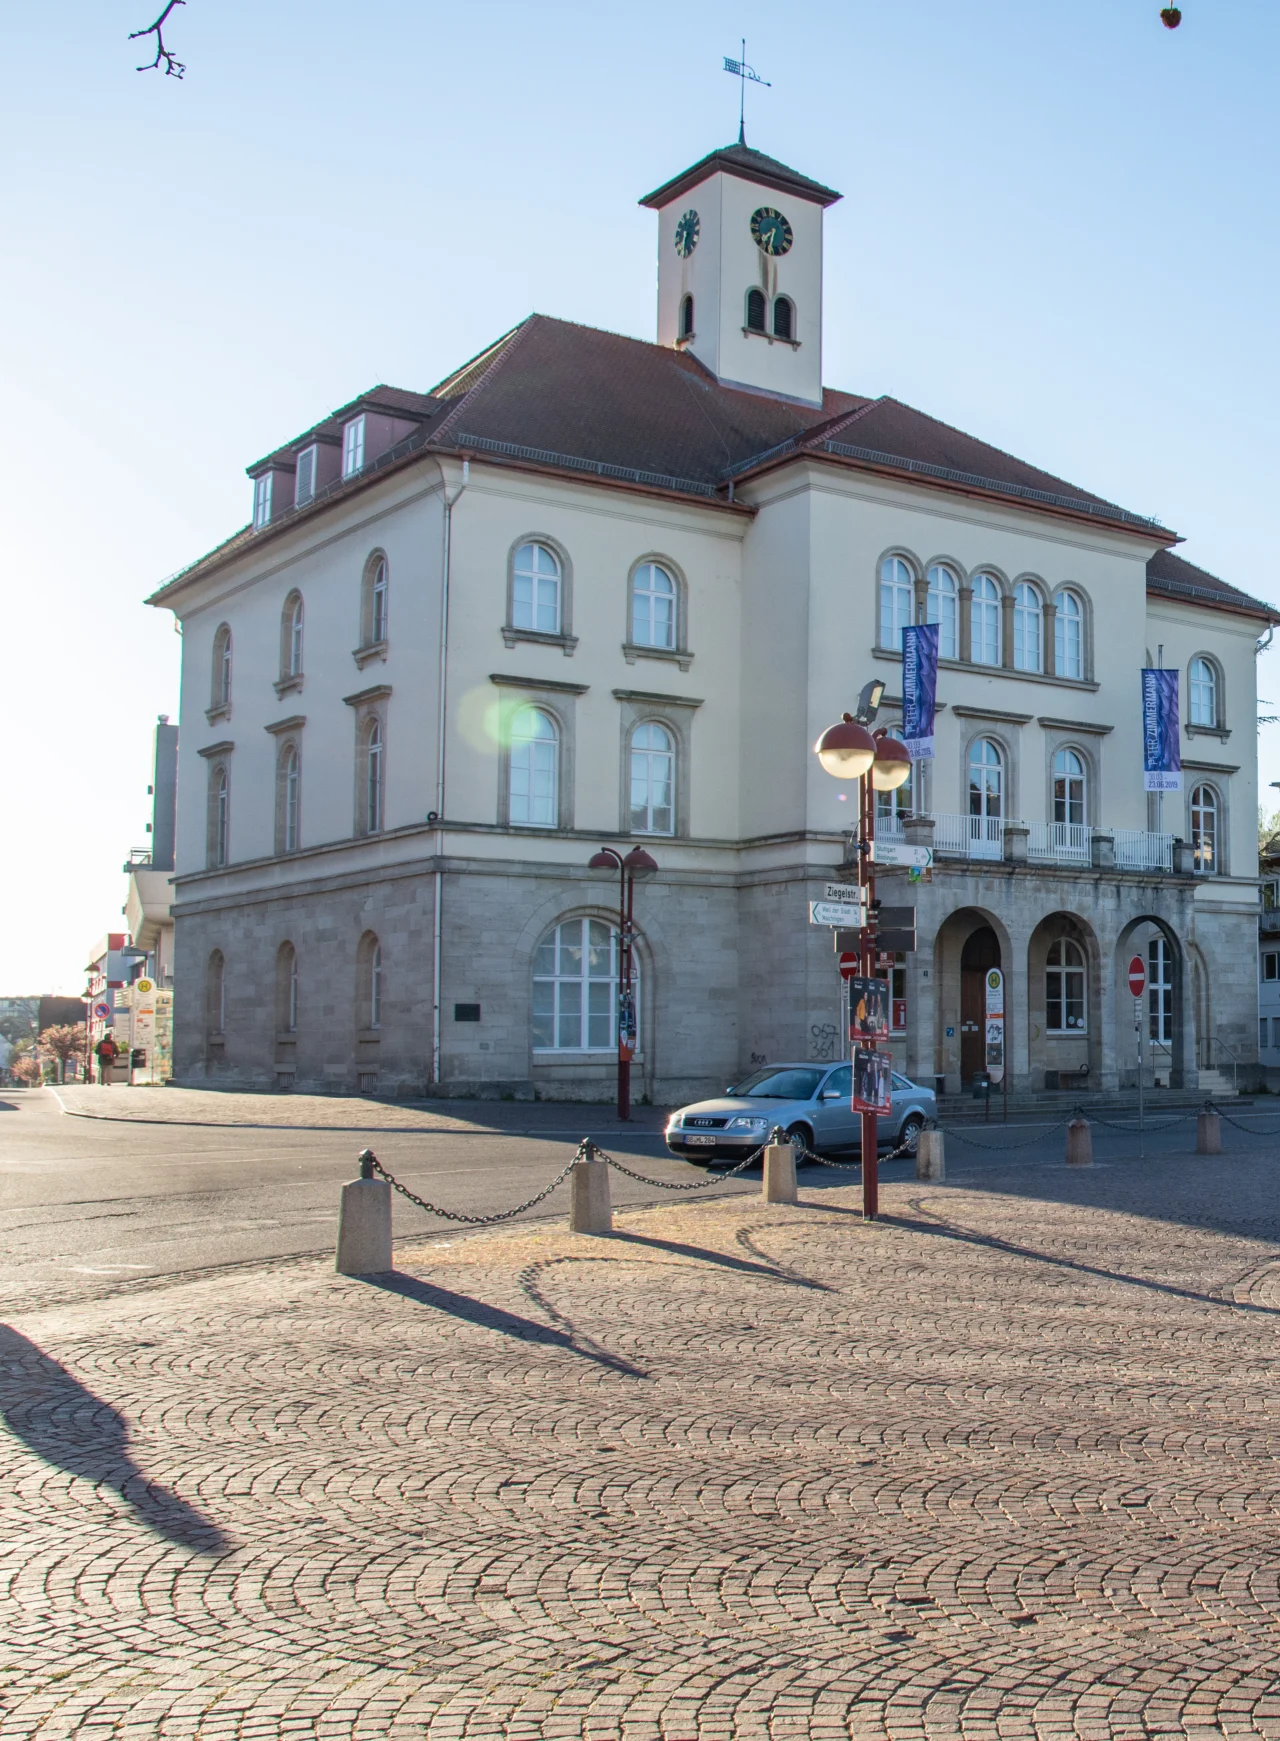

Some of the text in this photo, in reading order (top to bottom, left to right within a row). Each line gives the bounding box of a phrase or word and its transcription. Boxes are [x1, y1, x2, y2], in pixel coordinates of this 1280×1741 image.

[905, 632, 917, 733] PETER ZIMMERMANN
[1145, 674, 1159, 766] PETER ZIMMERMANN
[909, 747, 932, 758] 3.06.2019
[1148, 780, 1178, 789] 23.06.2019
[876, 845, 896, 854] Stuttgart
[827, 886, 859, 900] Ziegelstr.
[811, 1023, 839, 1040] 067
[809, 1040, 835, 1060] 361
